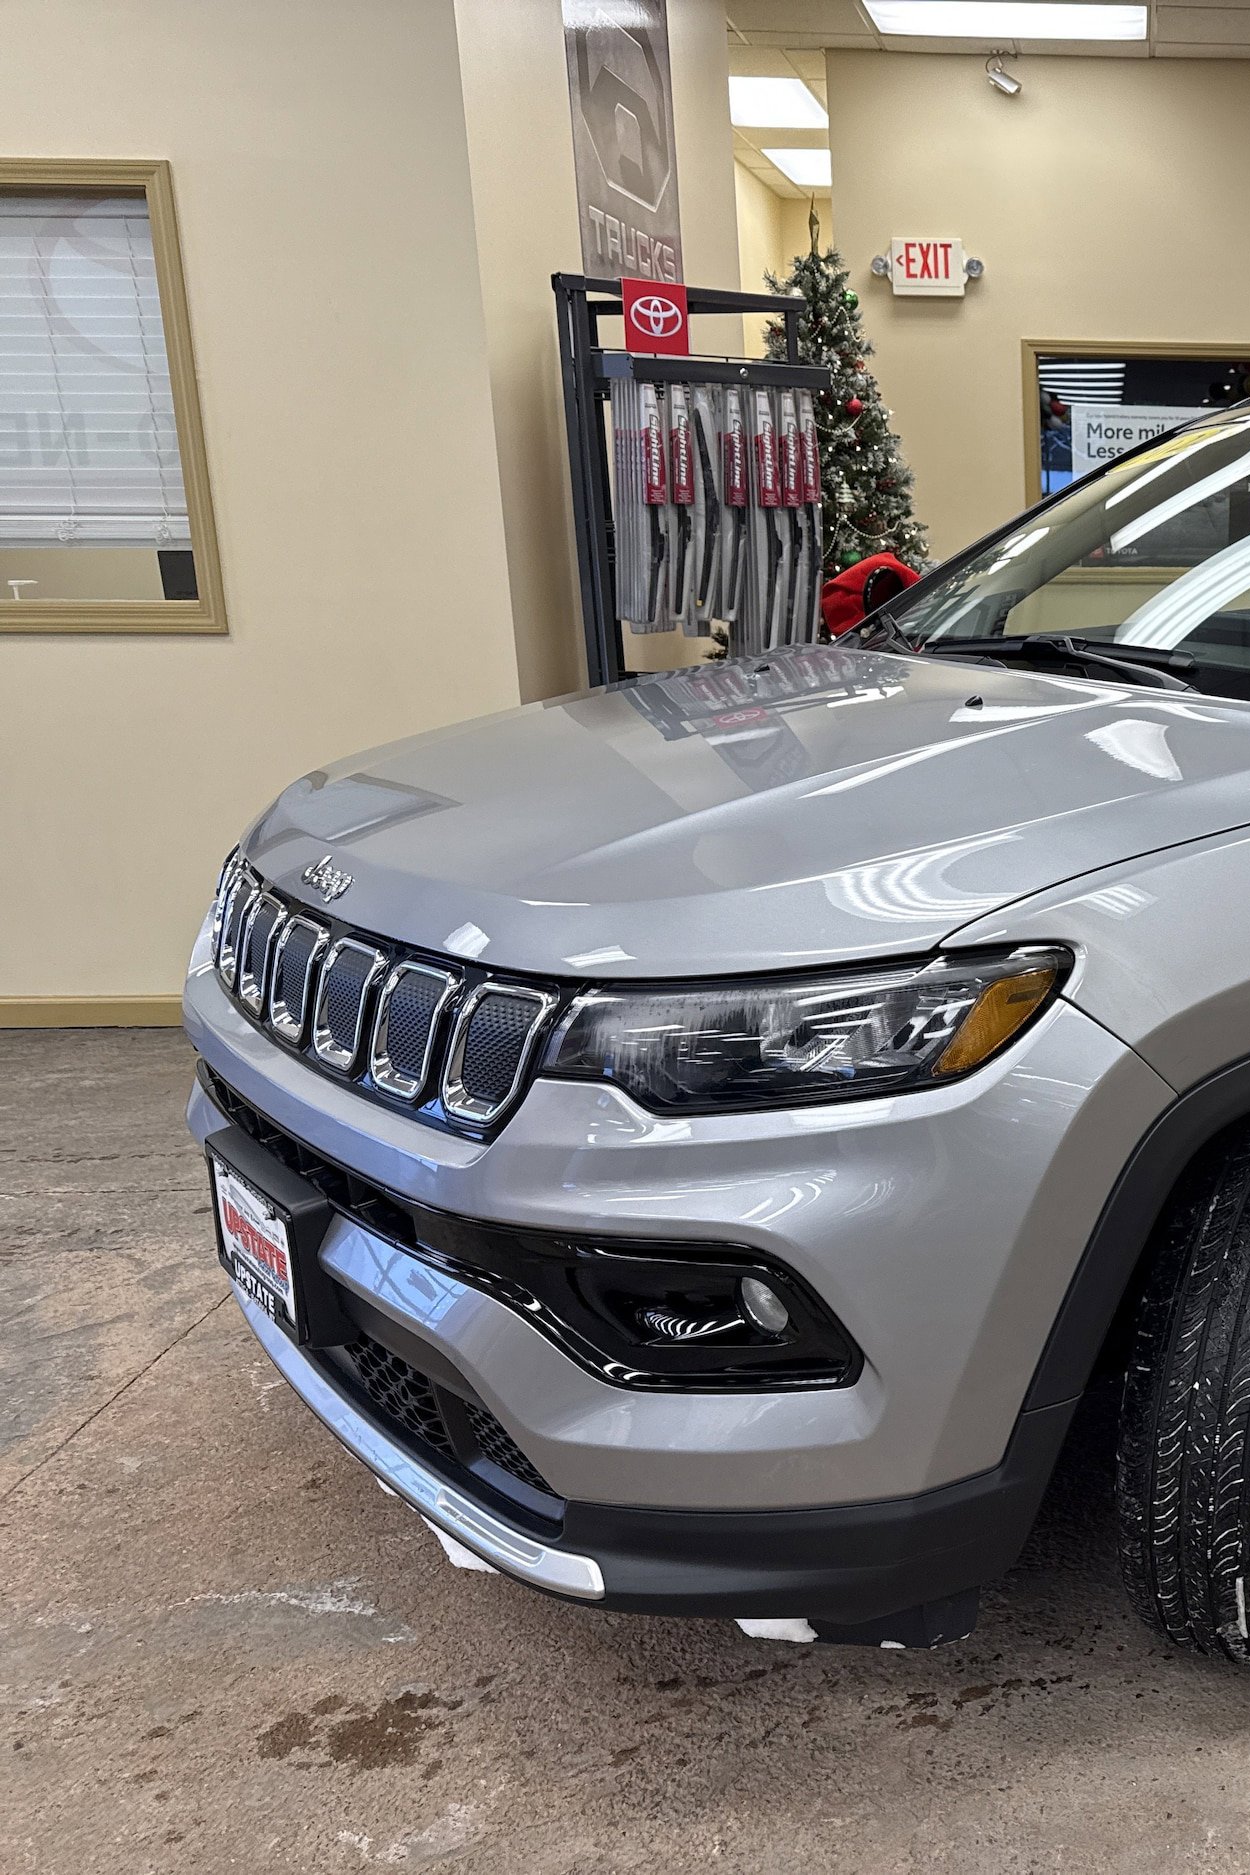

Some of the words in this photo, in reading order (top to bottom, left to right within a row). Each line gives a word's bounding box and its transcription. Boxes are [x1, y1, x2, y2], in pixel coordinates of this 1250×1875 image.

[588, 205, 677, 282] TRUCKS
[904, 242, 952, 279] EXIT
[649, 413, 661, 487] SightLine
[677, 414, 688, 487] SightLine
[732, 418, 743, 489] SightLine
[762, 420, 774, 490] SightLine
[786, 421, 798, 491] SightLine
[805, 418, 816, 487] SightLine
[1087, 422, 1133, 440] More
[302, 855, 353, 904] Jeep
[221, 1196, 288, 1281] UPSTATE
[234, 1258, 275, 1314] UPSTATE
